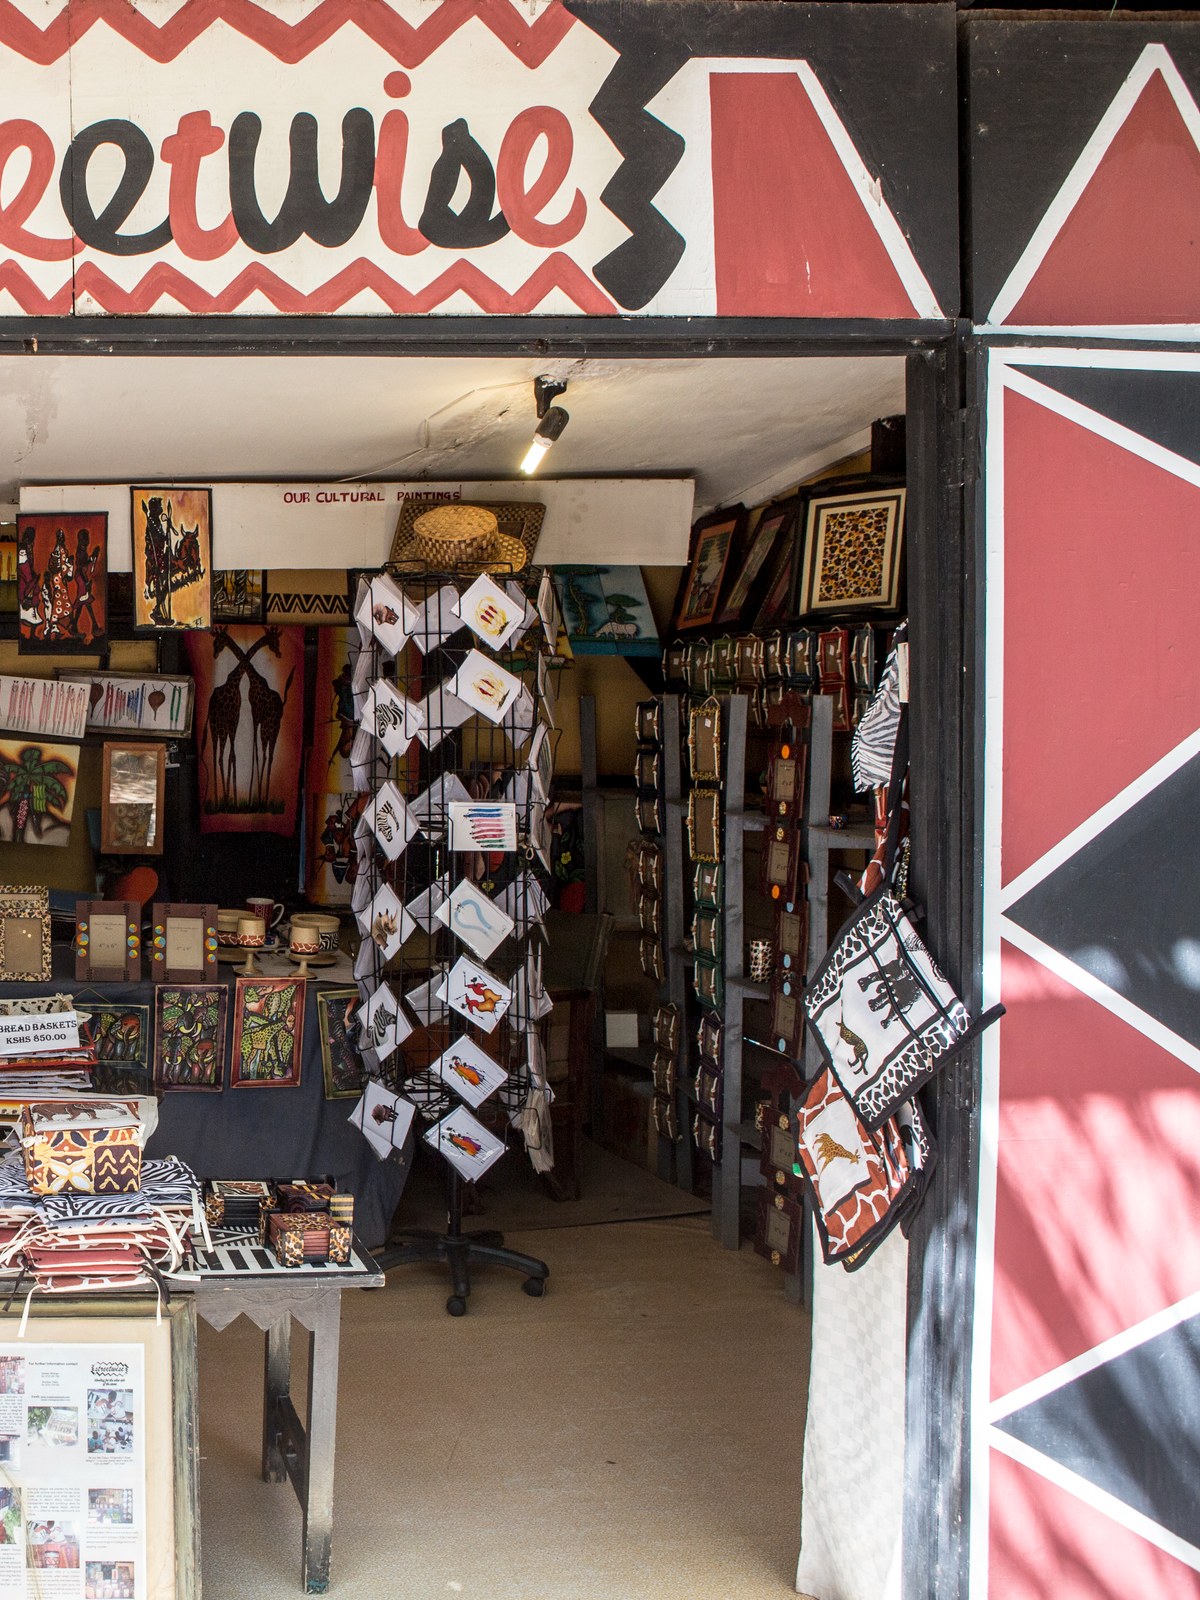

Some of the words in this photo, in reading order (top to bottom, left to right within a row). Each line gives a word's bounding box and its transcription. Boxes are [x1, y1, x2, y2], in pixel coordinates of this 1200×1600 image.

[283, 491, 311, 504] OUR
[315, 491, 385, 503] CULTURAL
[396, 491, 461, 501] PAINTINGS
[32, 1020, 78, 1031] BASKETS
[6, 1035, 32, 1045] KSHS
